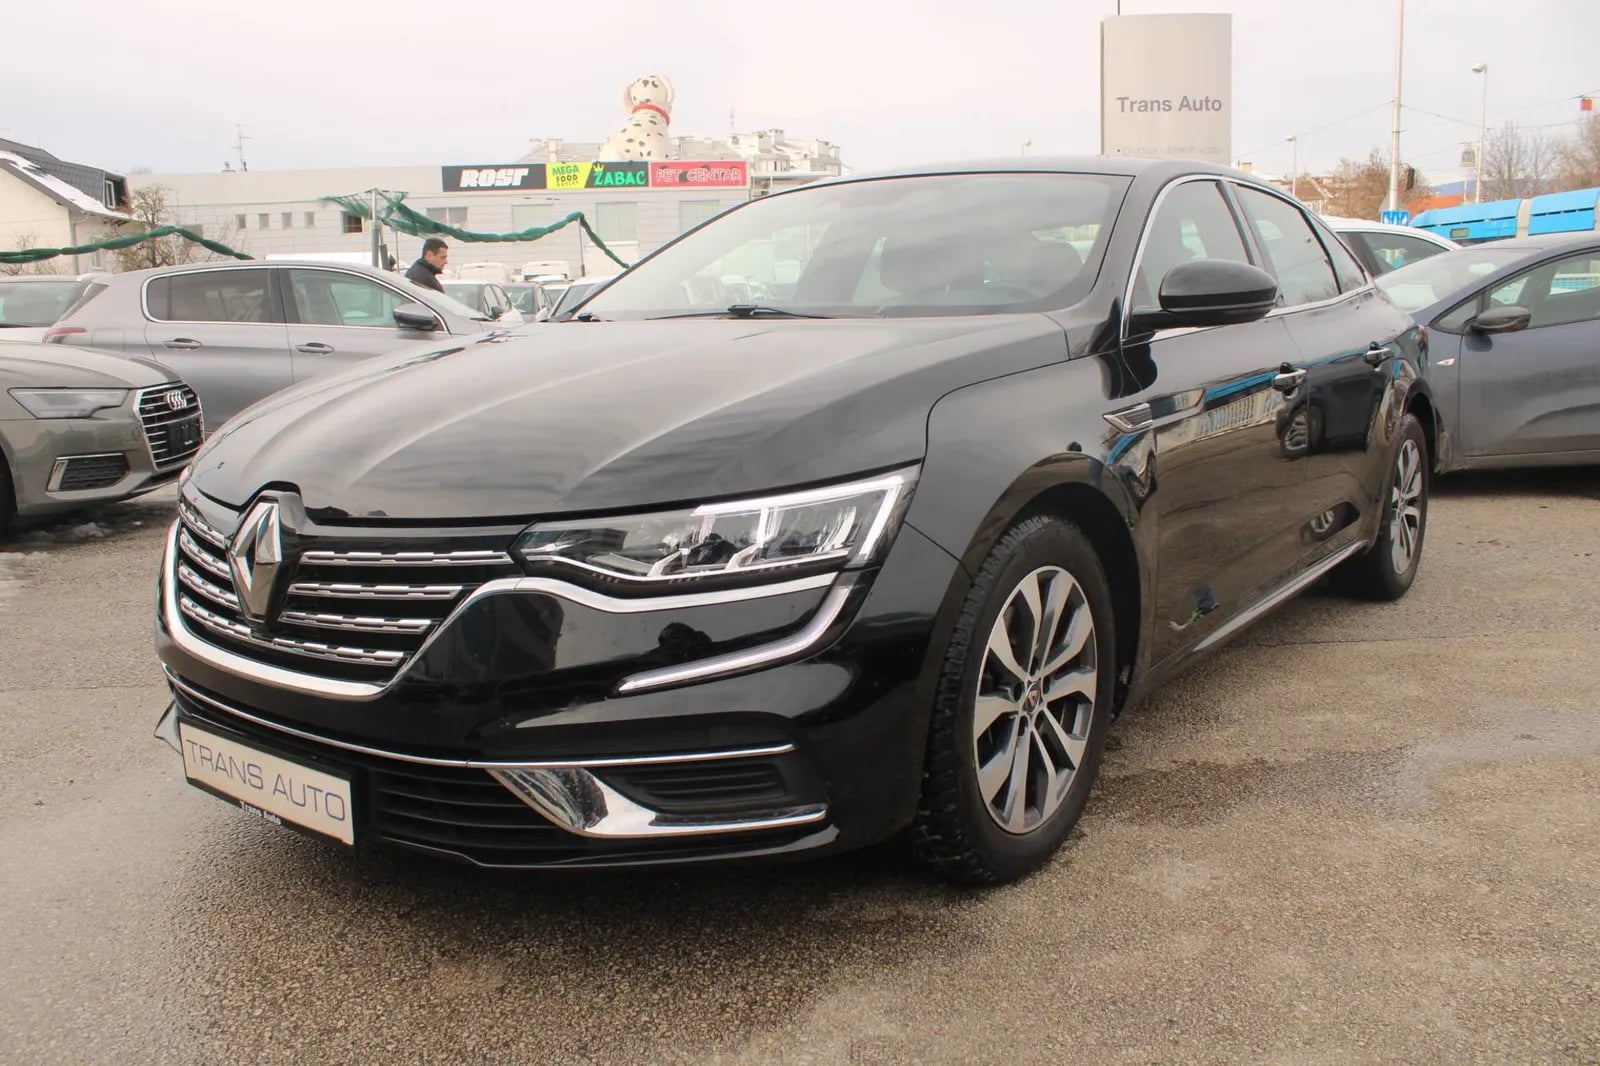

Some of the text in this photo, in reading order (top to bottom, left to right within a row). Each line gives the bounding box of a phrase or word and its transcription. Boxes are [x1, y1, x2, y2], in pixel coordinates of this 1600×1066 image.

[1116, 95, 1222, 112] Trans Auto
[459, 167, 529, 188] ROST
[552, 165, 579, 177] MEGA
[556, 174, 578, 183] FOOD
[656, 167, 741, 182] PET CENTAR
[186, 739, 345, 821] TRANS AUTO
